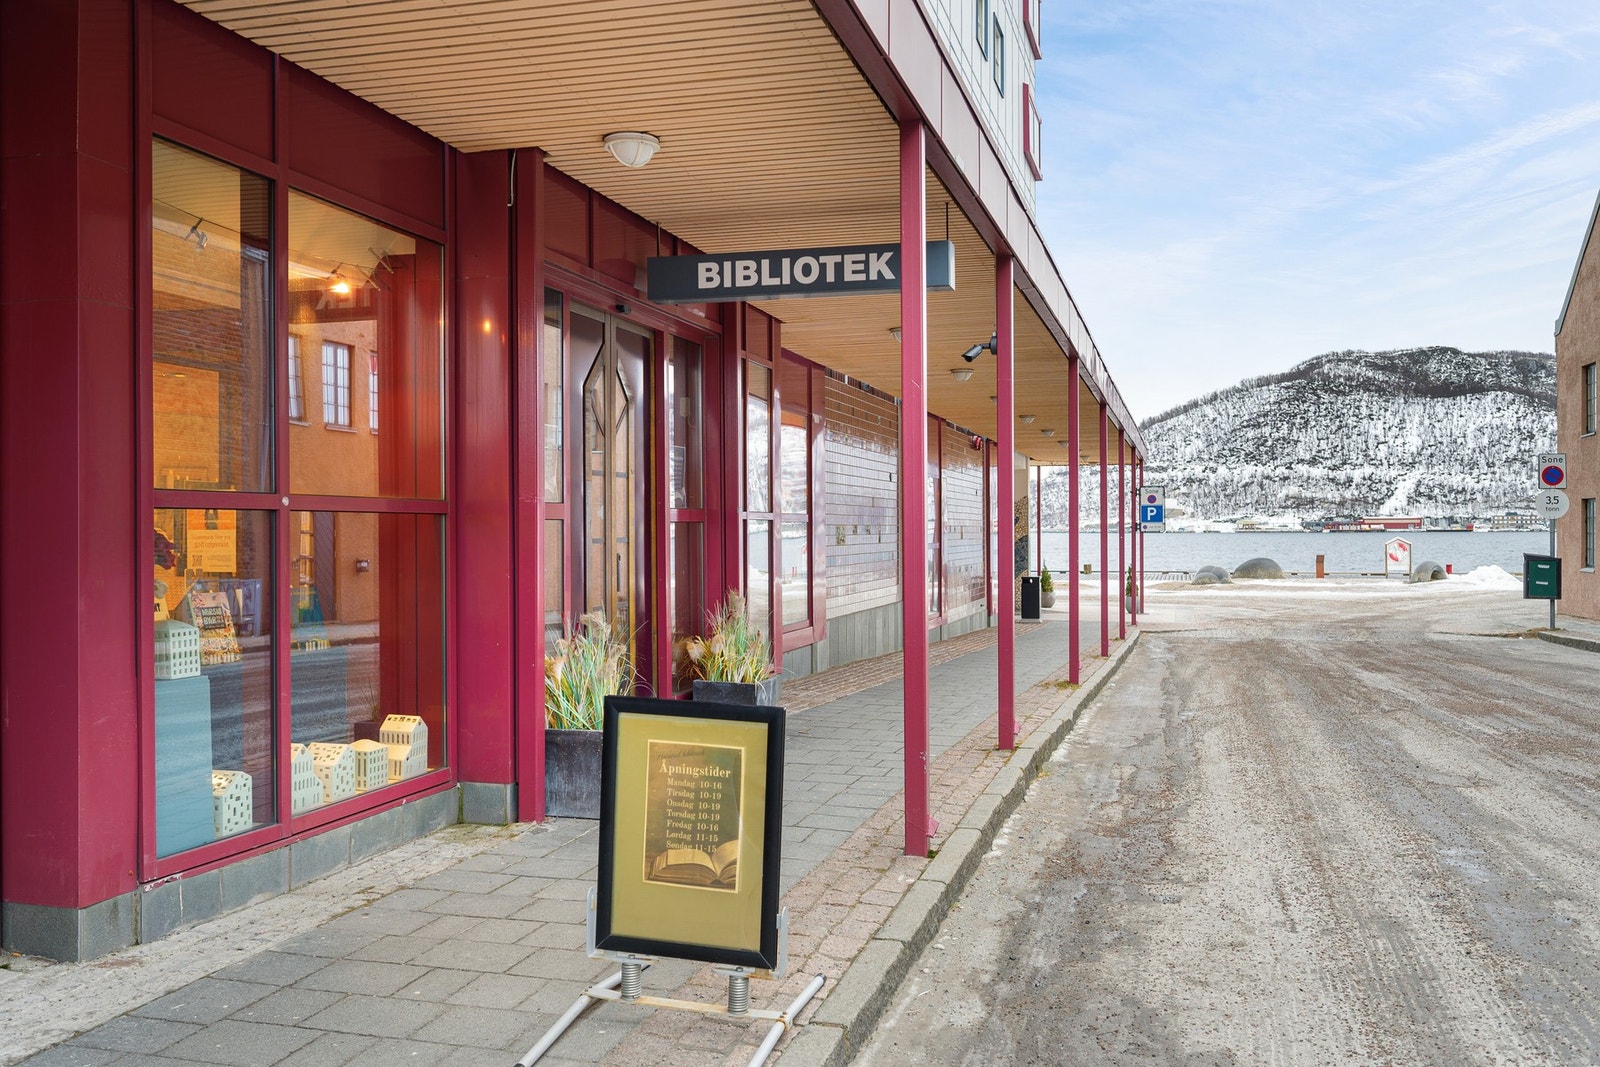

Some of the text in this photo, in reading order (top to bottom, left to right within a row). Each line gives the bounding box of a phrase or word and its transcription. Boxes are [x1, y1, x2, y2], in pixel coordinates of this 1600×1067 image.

[698, 252, 896, 289] BIBLIOTEK
[1147, 507, 1157, 520] P
[659, 759, 731, 778] Åpningstider
[667, 778, 722, 789] Mandag 10-16
[667, 788, 721, 800] Tirsdag 10-19
[667, 799, 720, 810] Onsdag 10-19
[666, 809, 720, 821] Torsdag 10-19
[667, 820, 719, 831] Fredag 10-16
[666, 830, 718, 842] Lørdag 11-15
[666, 841, 717, 852] Søndag 11-15
